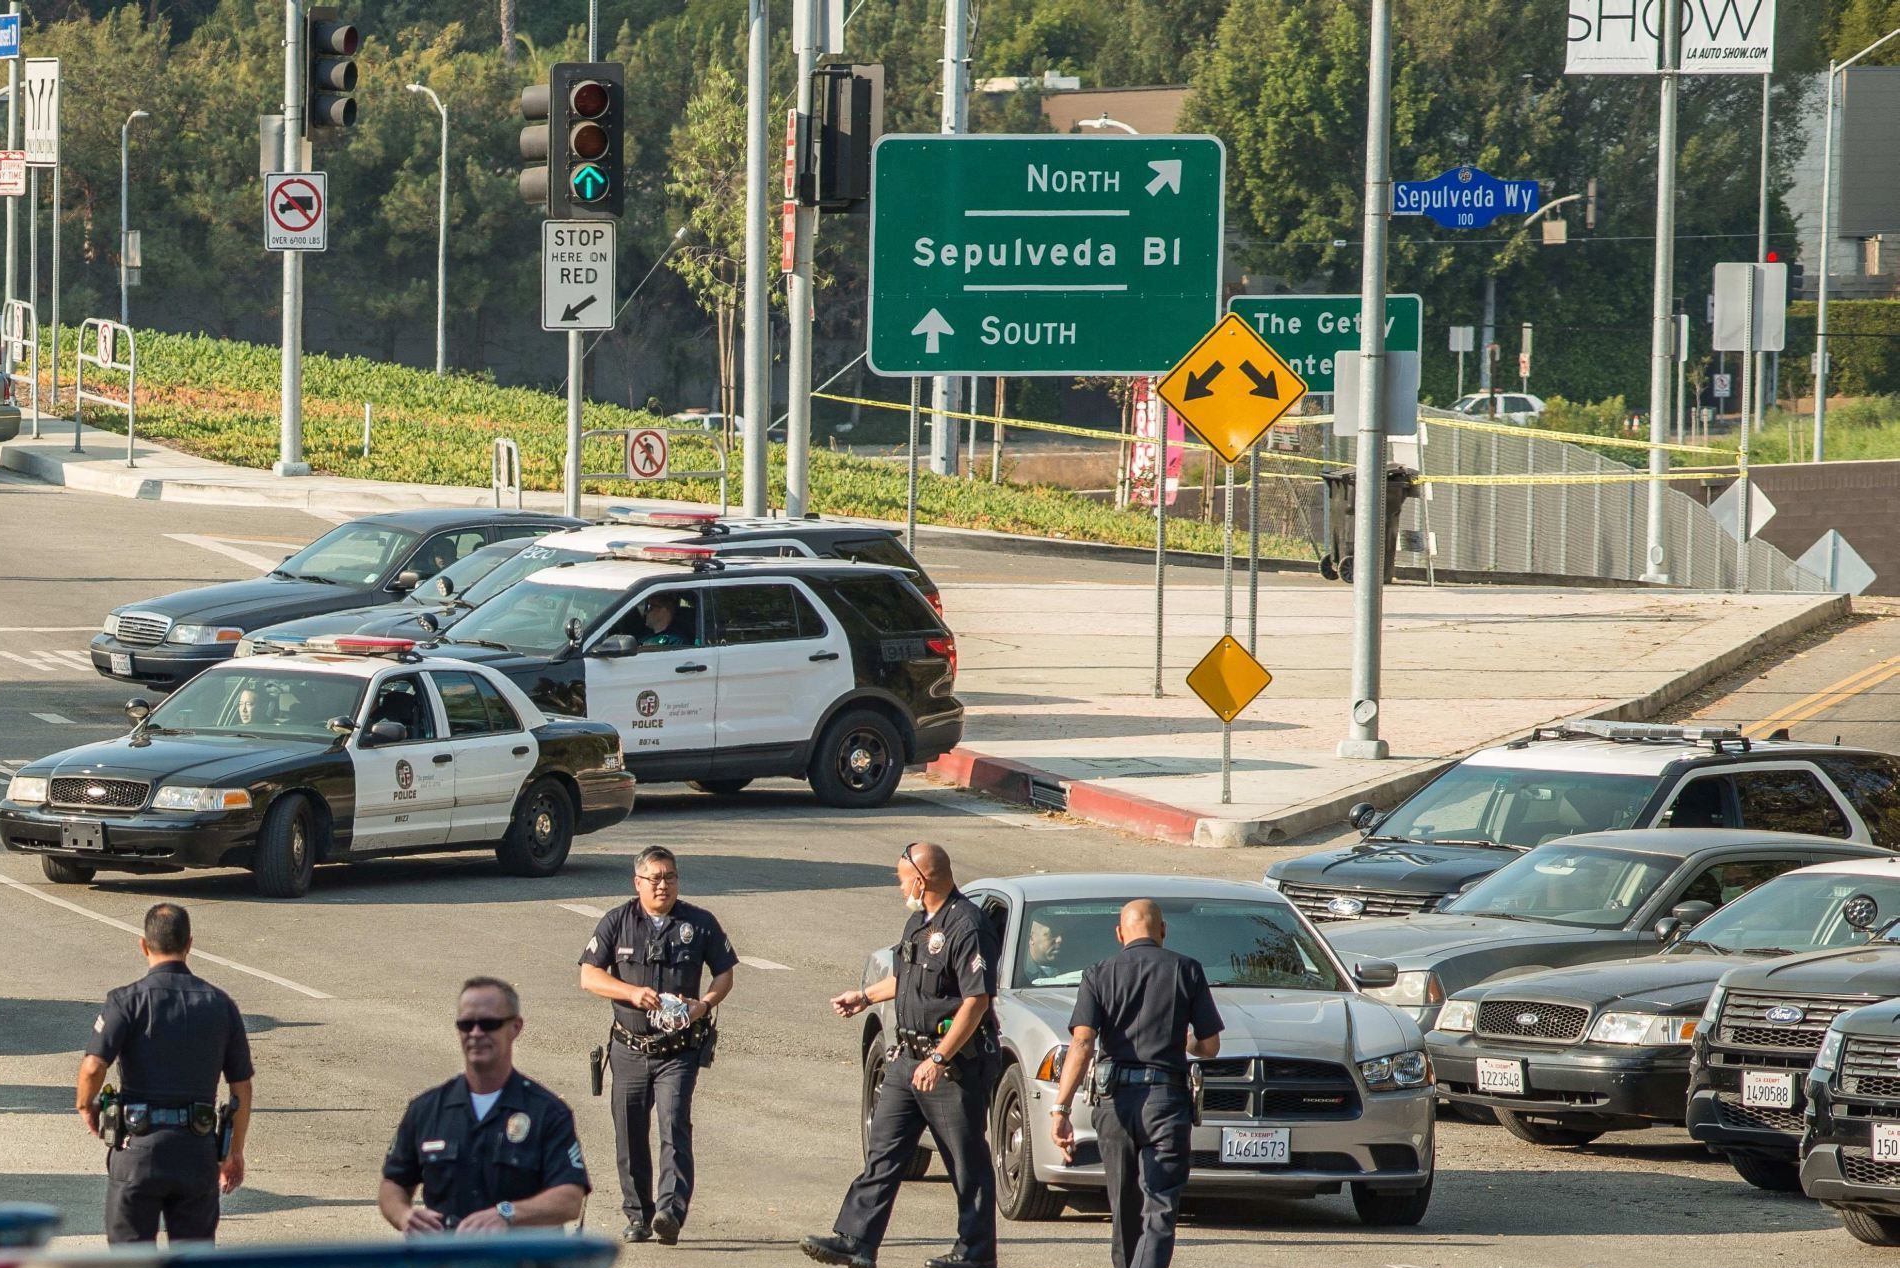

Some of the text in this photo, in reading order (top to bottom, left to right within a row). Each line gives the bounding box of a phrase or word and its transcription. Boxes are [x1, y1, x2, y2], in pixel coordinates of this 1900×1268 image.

[1686, 47, 1768, 59] LA AUTO SHOW.COM
[1027, 164, 1120, 193] NORTH
[1398, 184, 1532, 213] Sepulveda Wy
[1458, 213, 1474, 225] 100
[272, 237, 288, 245] OVER
[309, 236, 321, 244] LBS
[554, 229, 604, 246] STOP
[551, 252, 607, 262] HERE ON
[913, 237, 1180, 274] Sepulveda Bl
[560, 267, 598, 284] RED
[980, 316, 1076, 345] SOUTH
[1254, 312, 1396, 338] The Gety
[632, 719, 664, 729] POLICE
[393, 790, 417, 801] POLICE
[1771, 1008, 1795, 1020] Ford
[1481, 1070, 1520, 1087] 1223548
[1746, 1085, 1789, 1102] 1490588
[1226, 1141, 1285, 1158] 1461573
